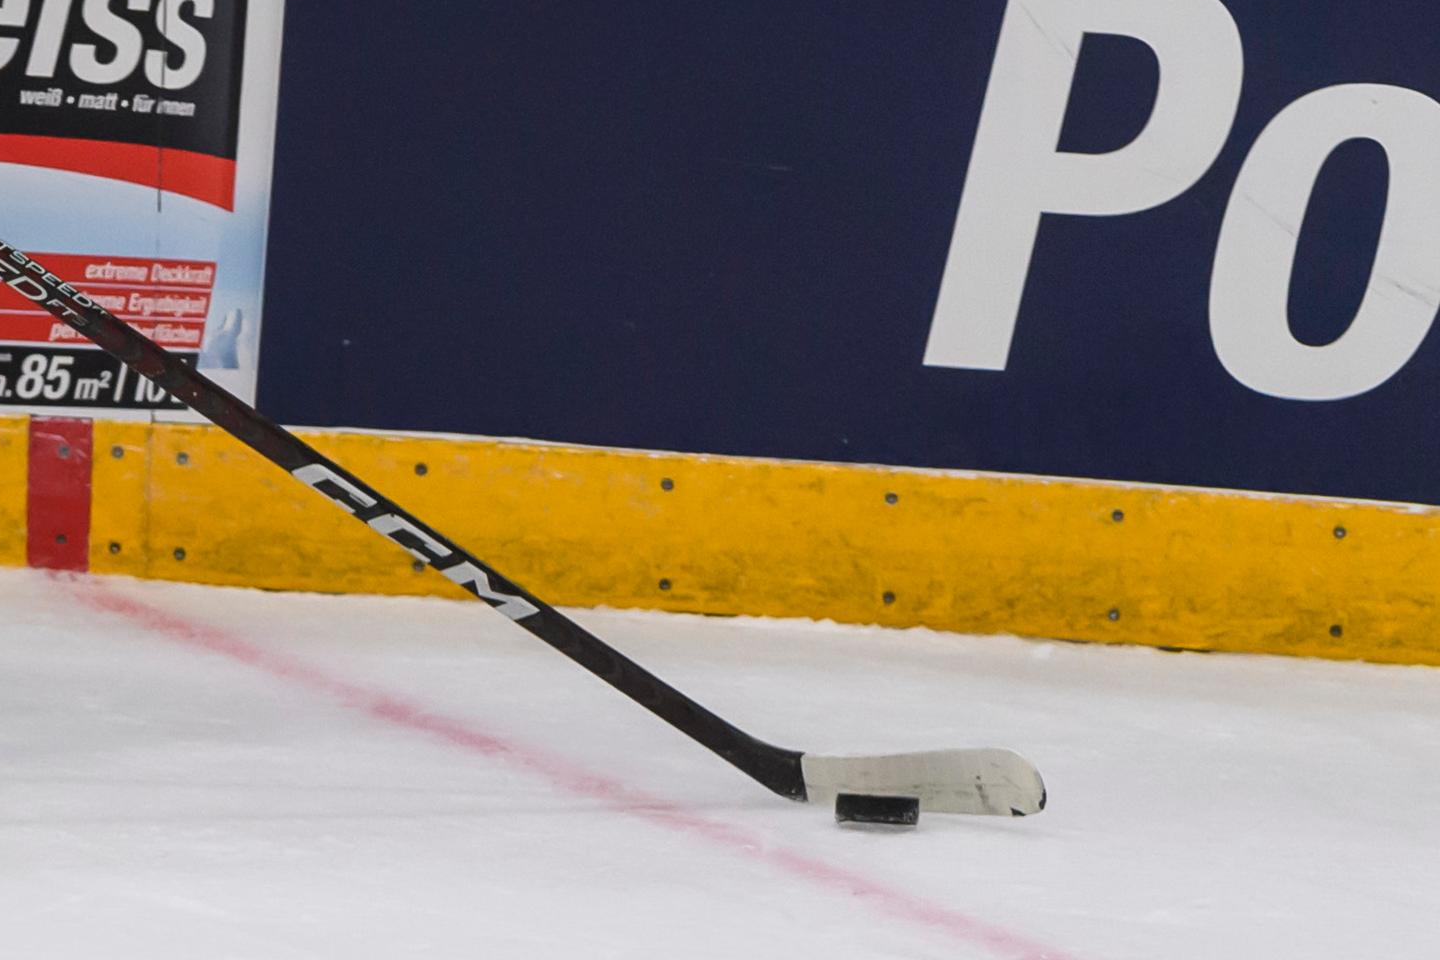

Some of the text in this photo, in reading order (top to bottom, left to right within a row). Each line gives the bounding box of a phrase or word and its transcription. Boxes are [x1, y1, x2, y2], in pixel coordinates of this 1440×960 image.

[78, 92, 118, 111] matt
[16, 354, 75, 400] 85
[291, 463, 540, 621] CCM
